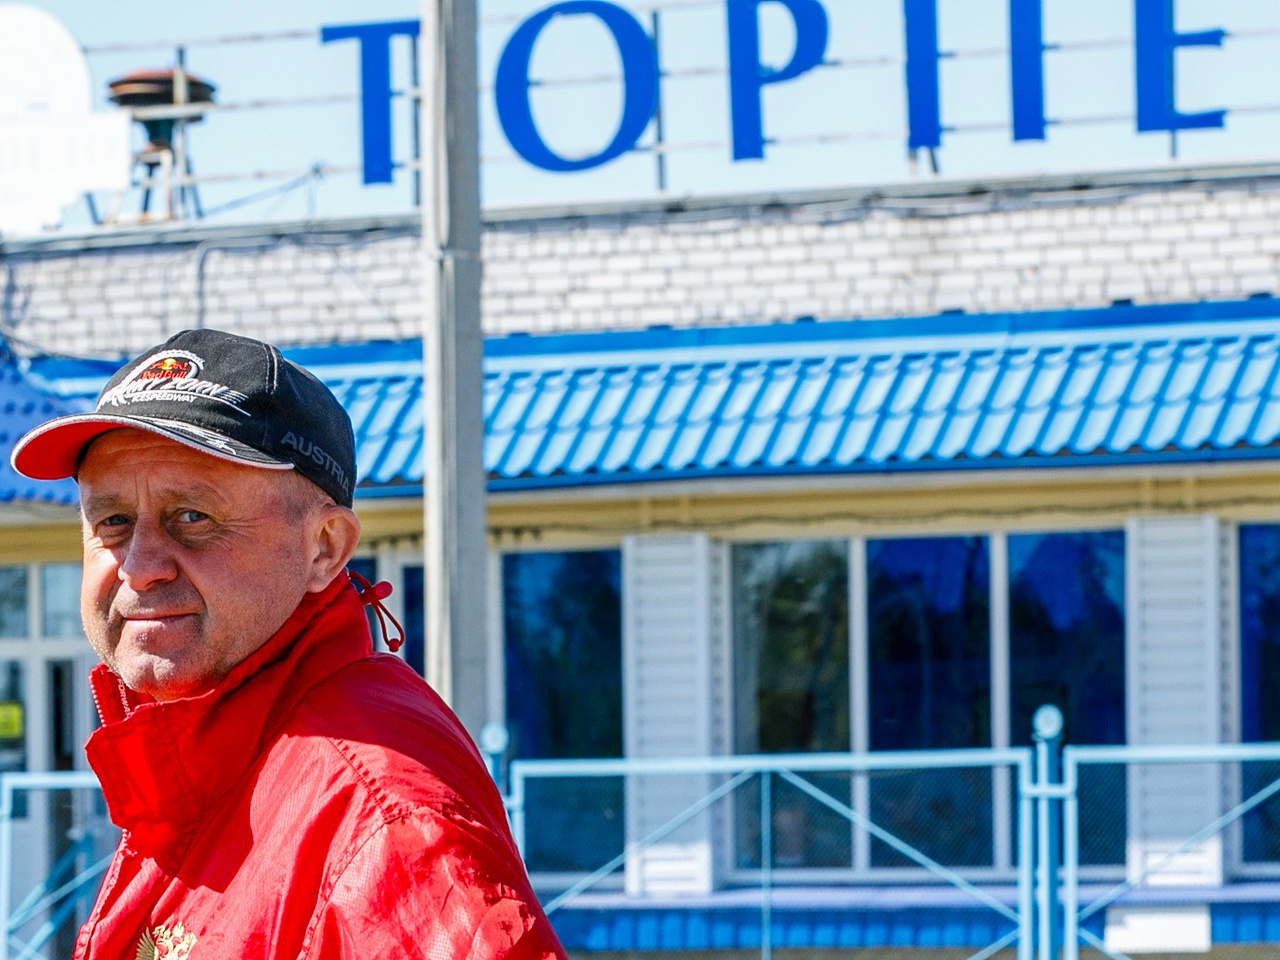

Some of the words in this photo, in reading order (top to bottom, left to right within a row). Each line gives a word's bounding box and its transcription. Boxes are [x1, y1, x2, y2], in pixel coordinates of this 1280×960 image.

[131, 391, 198, 403] ICESPEEDWAY
[279, 430, 350, 498] AUSTRIA
[116, 678, 131, 714] FORWA
